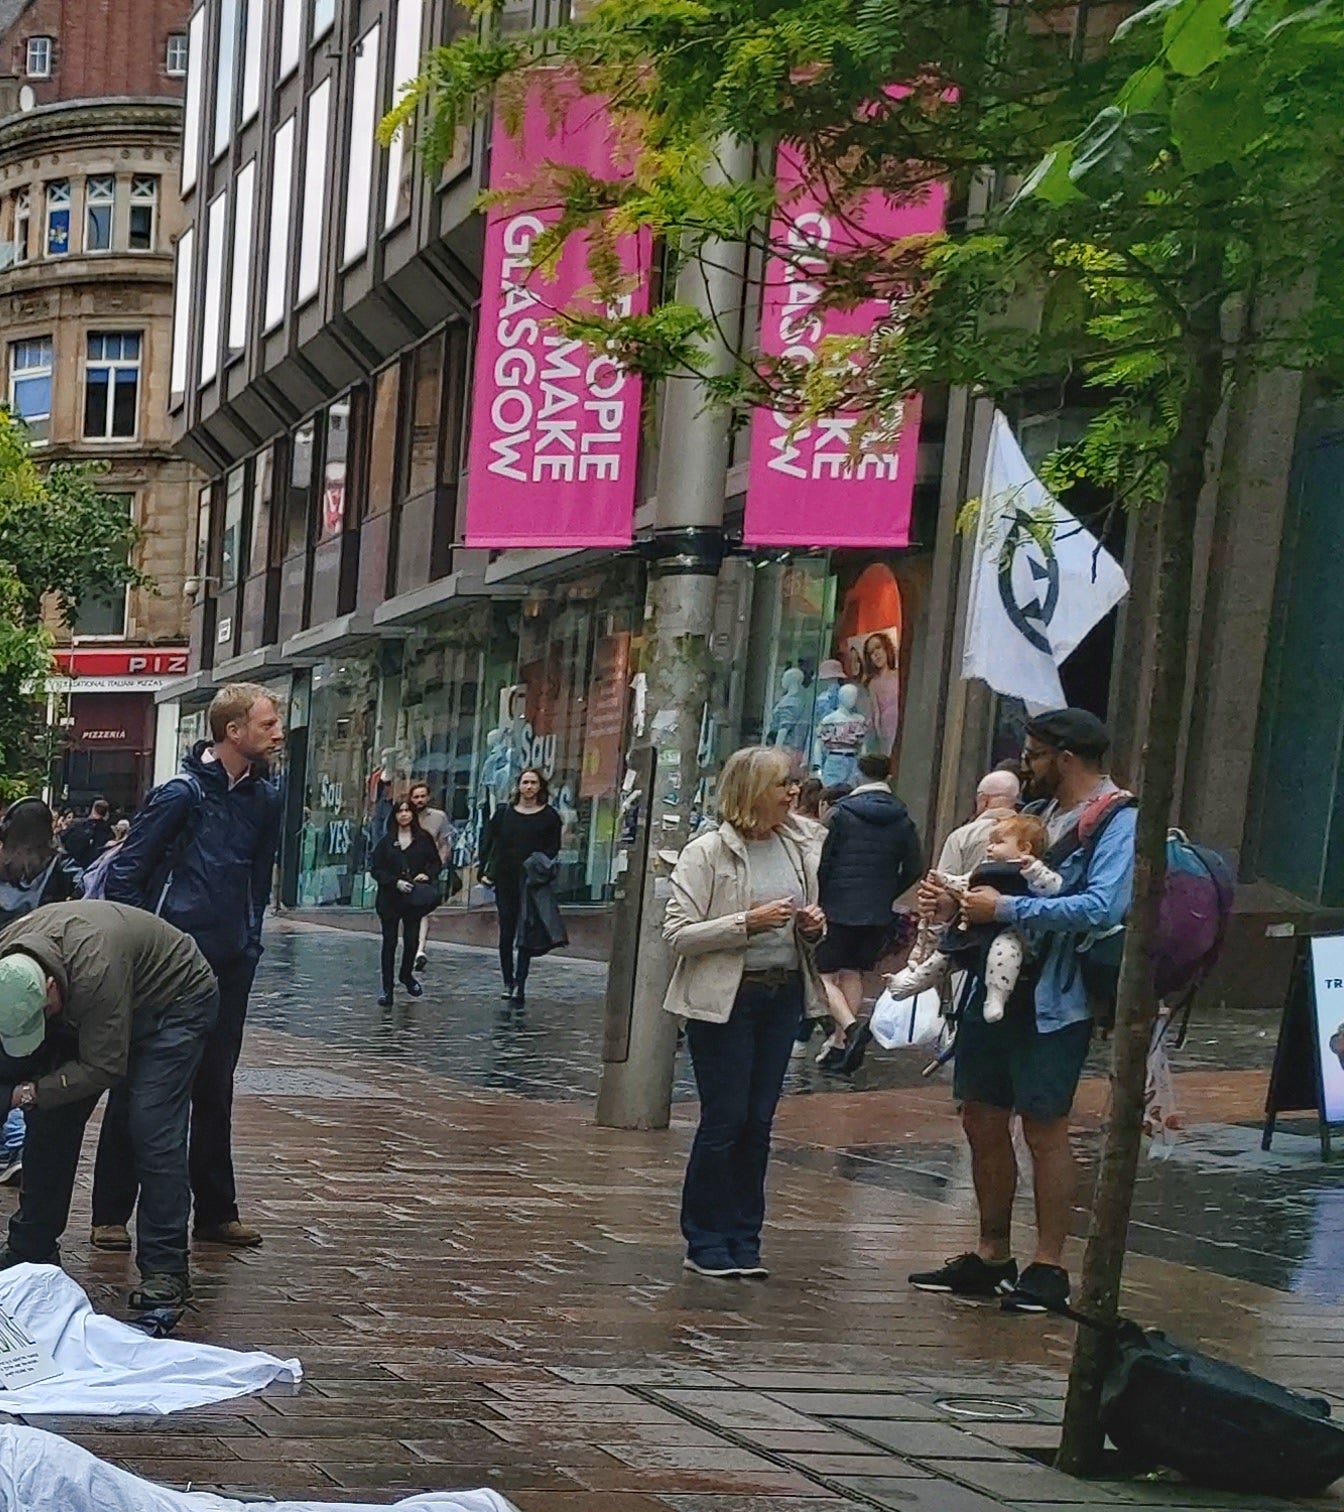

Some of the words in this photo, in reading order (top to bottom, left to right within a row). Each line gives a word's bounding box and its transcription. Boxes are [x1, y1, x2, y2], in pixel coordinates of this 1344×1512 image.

[487, 215, 544, 483] GLASGOW
[578, 290, 631, 482] POPLE
[534, 335, 582, 483] MAKE
[108, 679, 134, 688] ITALIAN
[137, 678, 164, 687] PIZZAS
[81, 731, 127, 740] PIZZERIA
[320, 774, 343, 815] Say
[328, 819, 353, 855] YES
